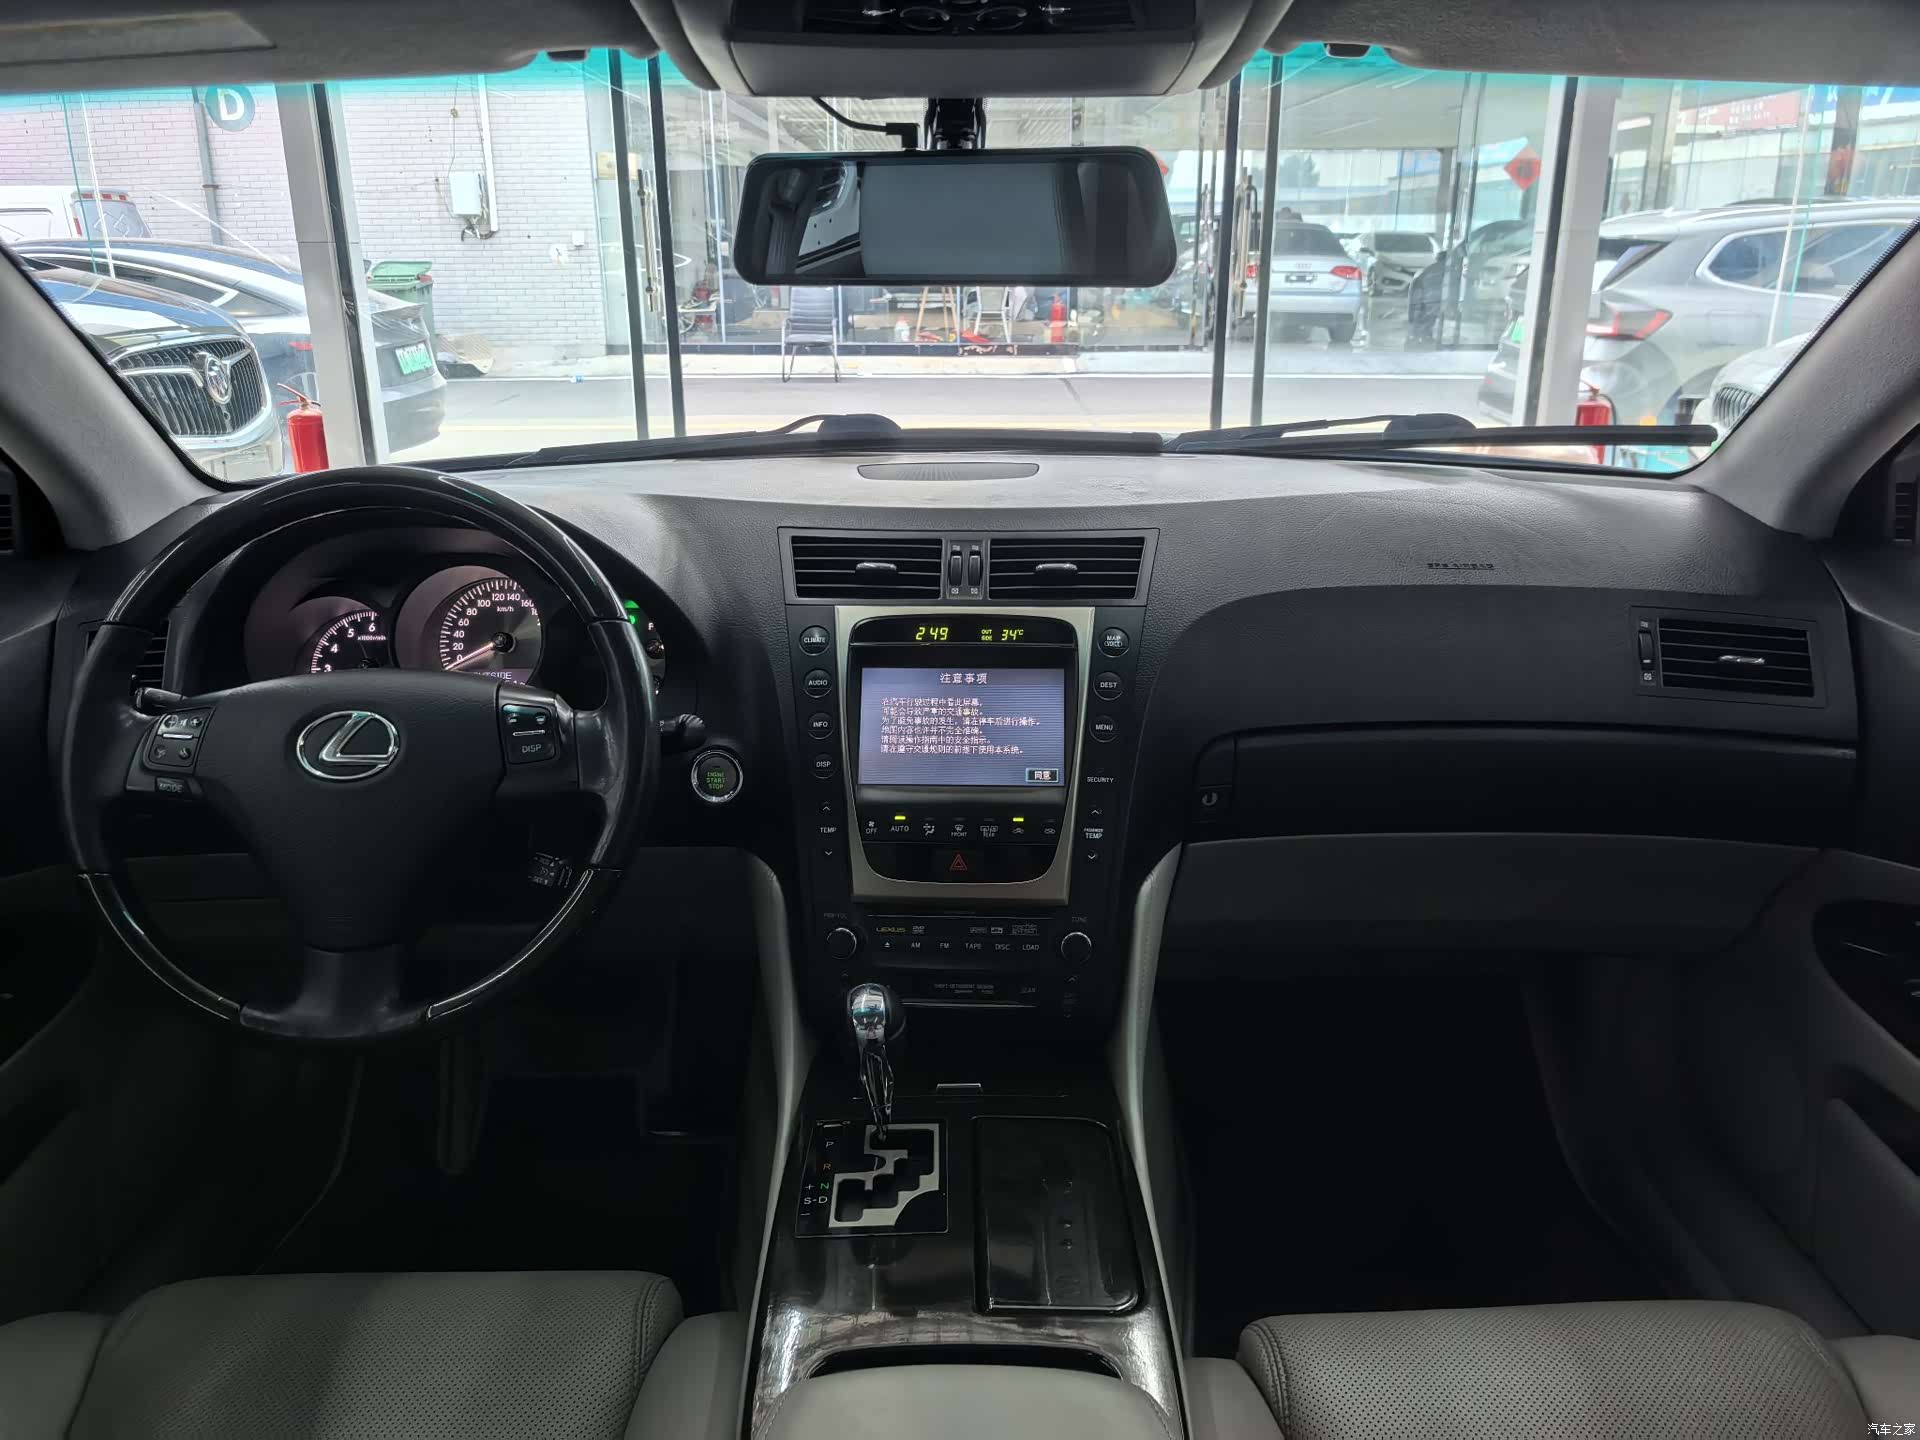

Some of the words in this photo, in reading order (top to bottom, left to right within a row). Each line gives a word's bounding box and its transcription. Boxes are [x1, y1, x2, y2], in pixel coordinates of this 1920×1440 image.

[217, 88, 244, 120] D
[458, 618, 469, 626] 60
[368, 623, 376, 632] 6
[347, 629, 355, 638] 5
[330, 644, 338, 653] 4
[940, 673, 988, 684] 注意事项
[522, 744, 541, 753] DISP
[1034, 771, 1051, 780] 同意
[1087, 776, 1114, 784] SECURITY
[159, 783, 183, 793] MODE
[820, 1182, 830, 1190] N
